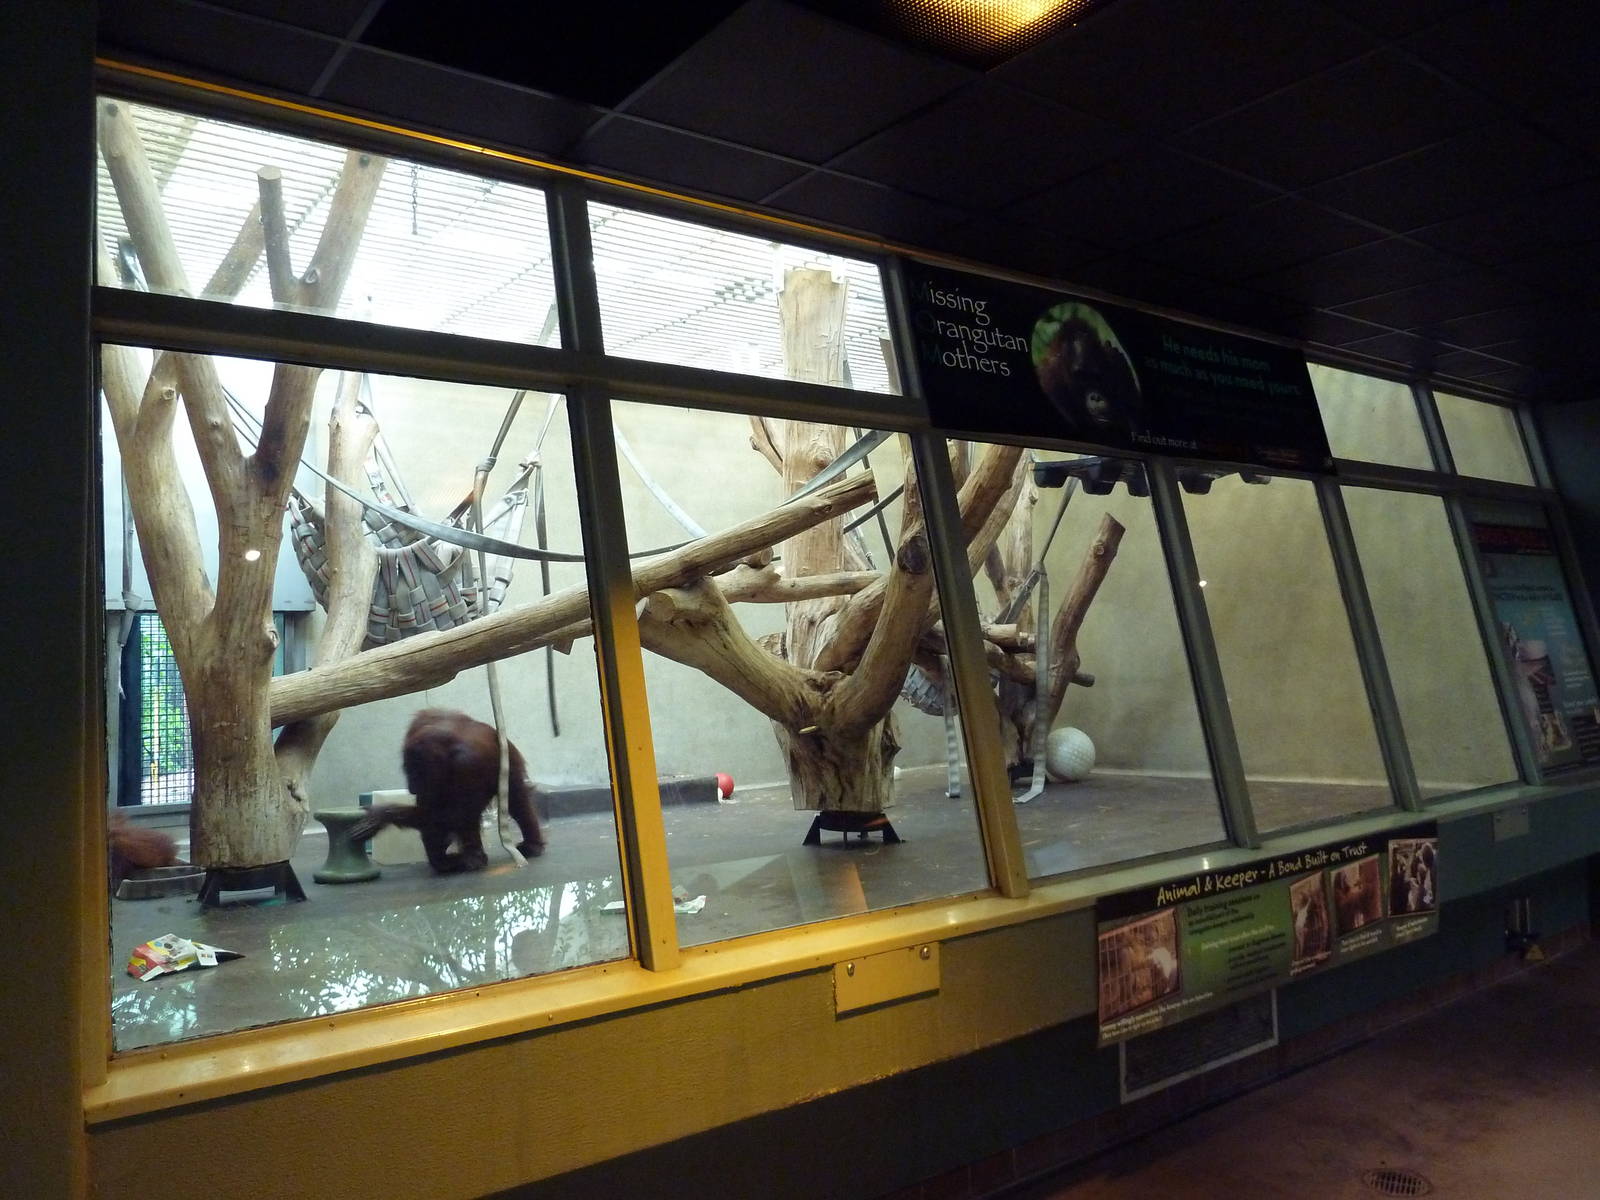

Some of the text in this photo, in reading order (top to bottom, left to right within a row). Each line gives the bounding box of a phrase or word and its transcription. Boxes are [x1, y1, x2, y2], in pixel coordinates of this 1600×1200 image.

[1183, 344, 1221, 363] needs
[1157, 876, 1200, 906] Animal
[1204, 875, 1214, 892] &
[1215, 867, 1258, 892] Keeper
[1268, 863, 1276, 880] A
[1279, 858, 1302, 876] Bond
[1304, 849, 1329, 869] Built
[1330, 850, 1342, 862] on
[1343, 842, 1369, 862] Trust
